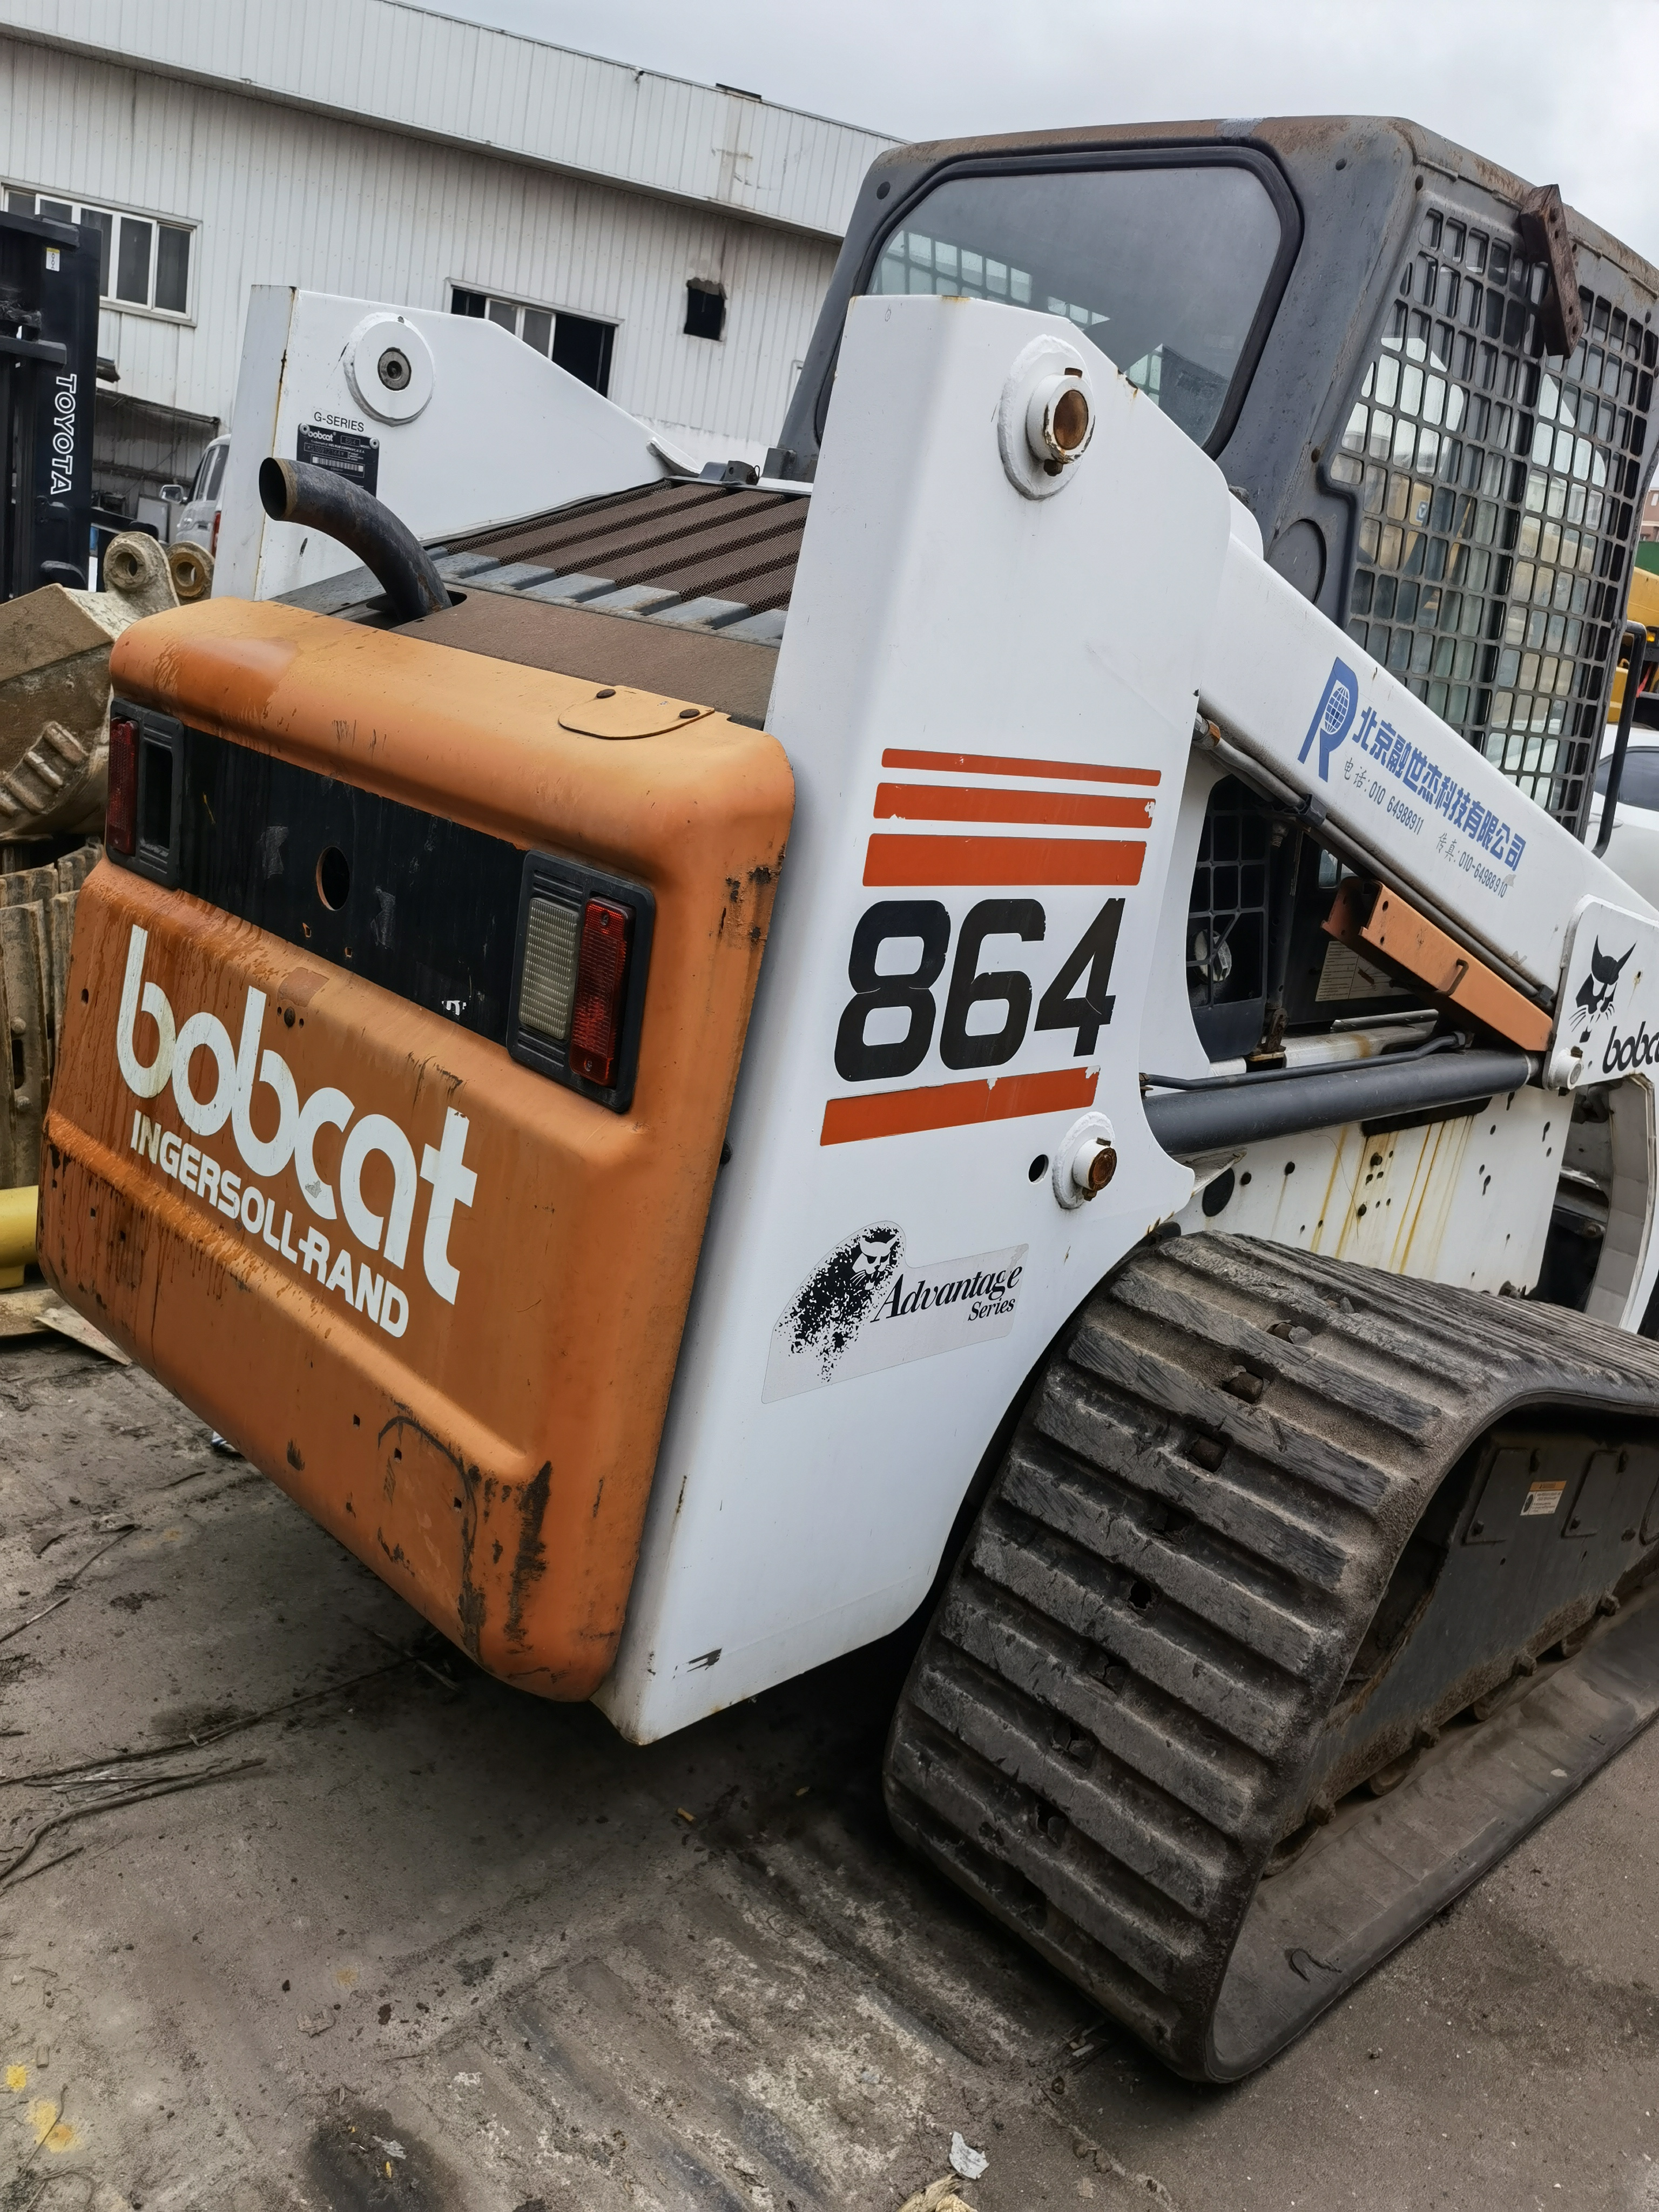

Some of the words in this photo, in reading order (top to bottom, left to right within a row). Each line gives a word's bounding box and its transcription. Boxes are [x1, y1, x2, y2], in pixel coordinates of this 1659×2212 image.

[51, 374, 77, 495] TOYOTA
[314, 412, 365, 432] G-SERIES
[1352, 706, 1526, 872] 北京融世杰科技有限公司
[1387, 796, 1424, 835] 64988911
[834, 898, 1125, 1082] 864
[117, 924, 478, 1305] bobcat
[131, 1109, 409, 1339] INGERSOLL-RAND
[870, 1266, 1022, 1323] Advantage
[968, 1297, 1015, 1321] Series
